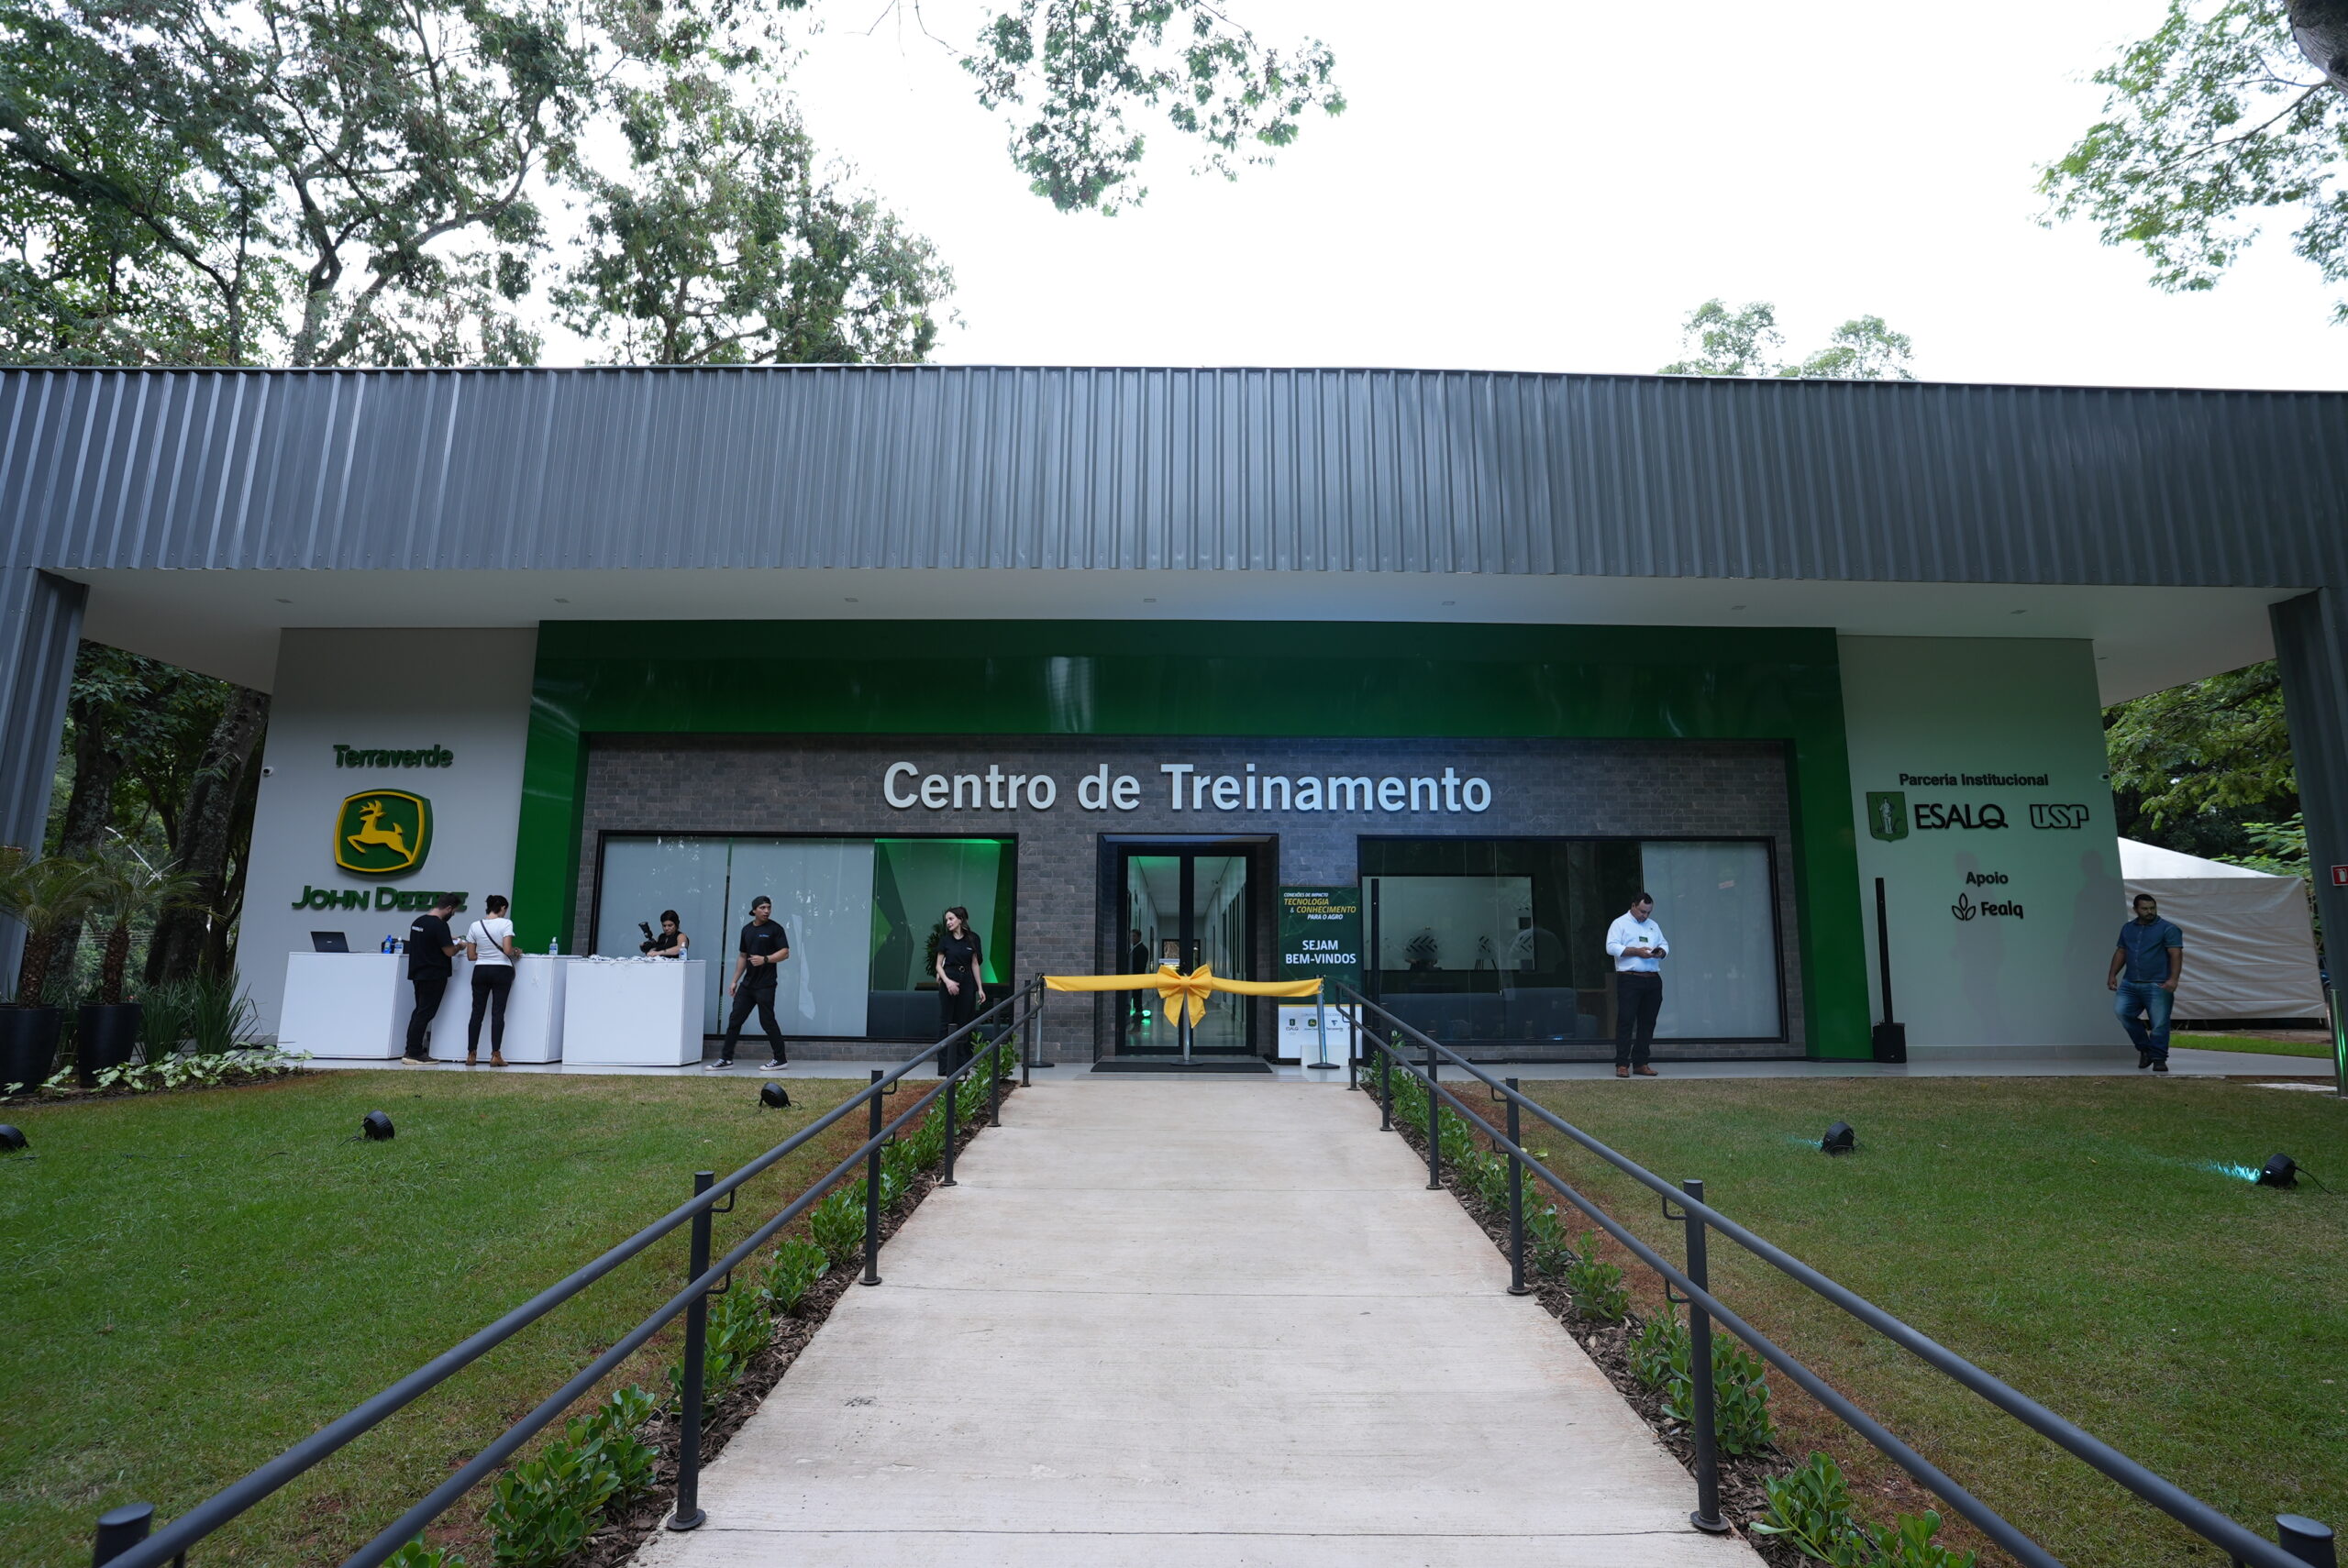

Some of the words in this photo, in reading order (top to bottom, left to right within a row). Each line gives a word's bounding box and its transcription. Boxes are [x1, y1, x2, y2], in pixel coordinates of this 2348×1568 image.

[333, 744, 454, 767] Terraverde
[883, 761, 1057, 811] Centro
[1078, 764, 1141, 811] de
[1160, 763, 1492, 812] Treinamento
[1899, 773, 1957, 786] Parceria
[1961, 773, 2049, 786] Institucional
[1914, 803, 2009, 829] ESALQ
[2030, 803, 2089, 829] USP
[1966, 871, 2009, 887] Apoio
[292, 885, 371, 911] JOHN
[375, 887, 469, 911] DEEE
[1284, 898, 1329, 906] TECNOLOGIA
[1980, 900, 2024, 919] Fealq
[1302, 940, 1338, 950] SEJAM
[1285, 953, 1357, 964] BEM-VINDOS
